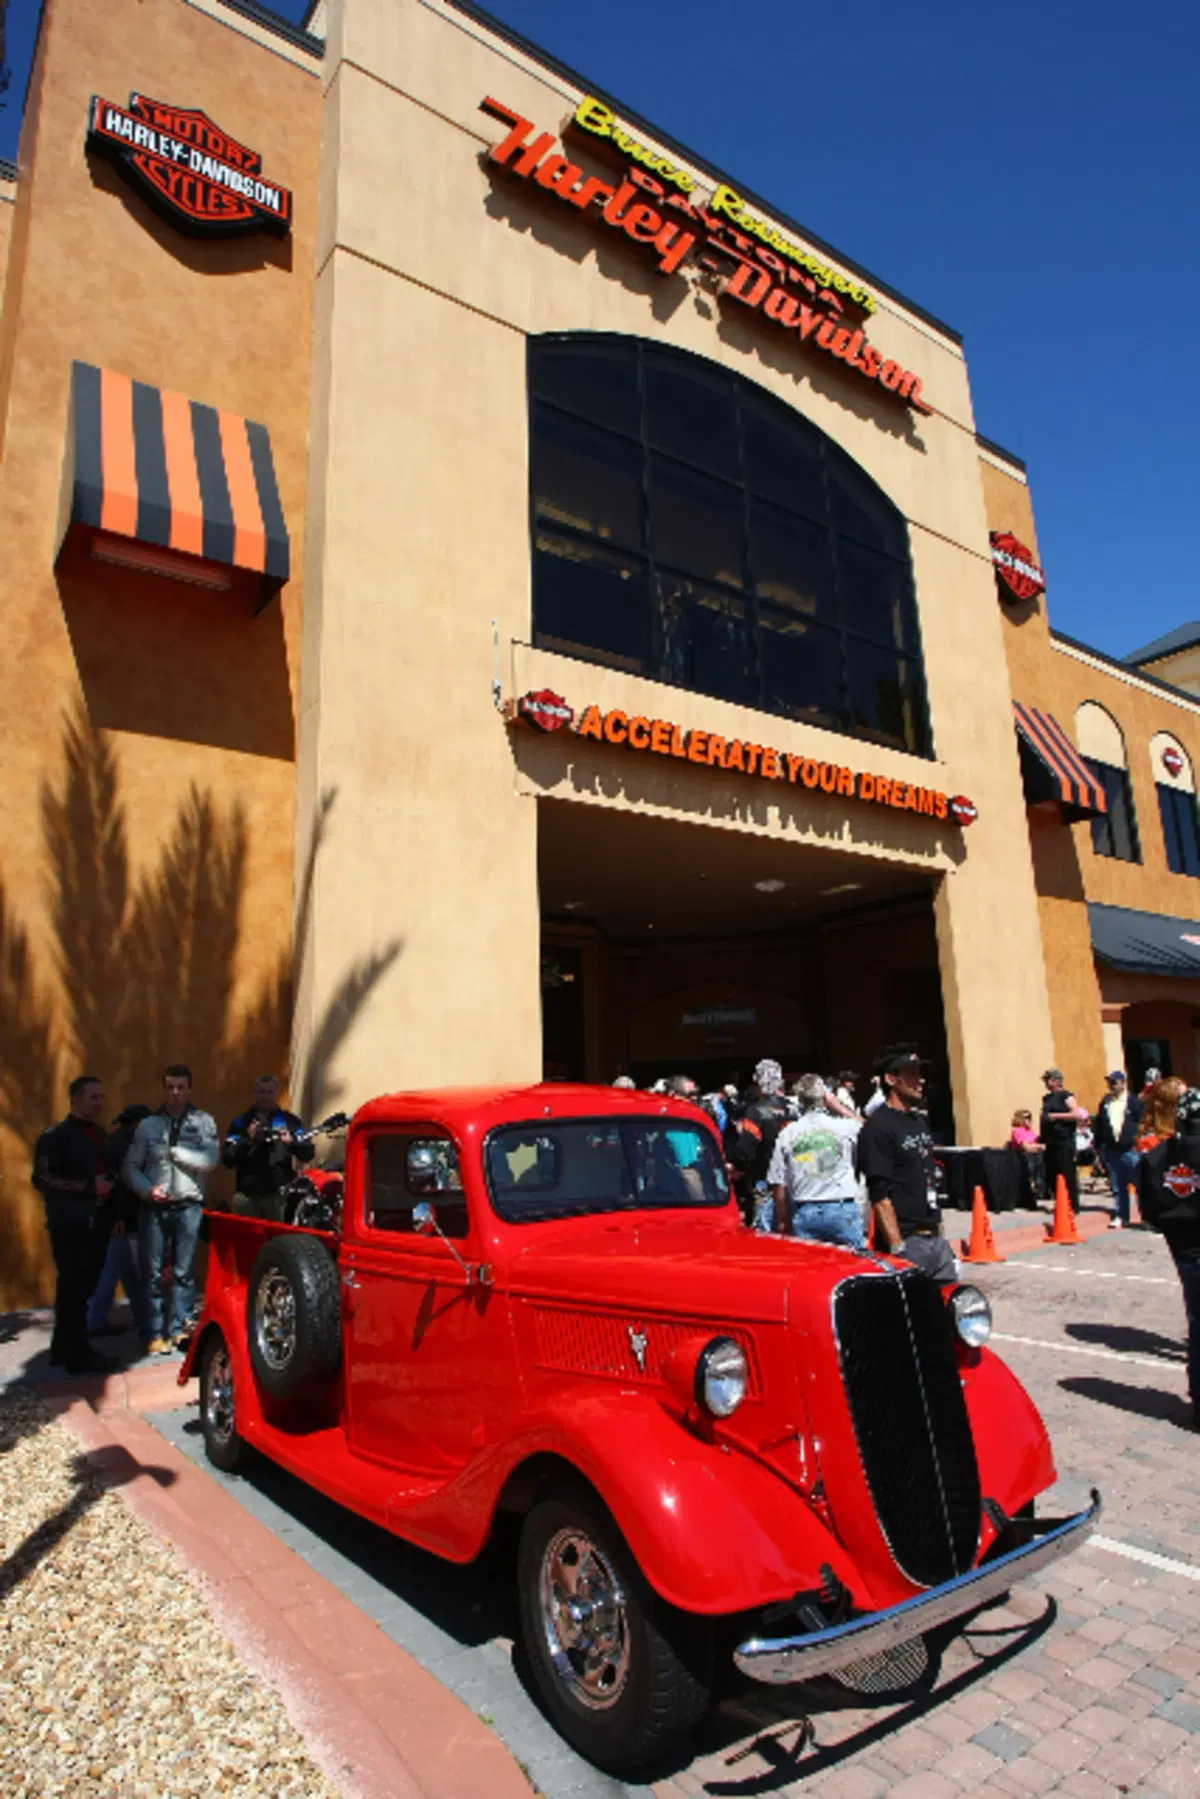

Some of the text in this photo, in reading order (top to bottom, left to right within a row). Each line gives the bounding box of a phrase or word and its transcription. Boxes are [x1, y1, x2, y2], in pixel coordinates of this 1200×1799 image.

[106, 109, 280, 212] HARLEY-DAVIDSON
[153, 106, 242, 165] MOTOR
[575, 95, 696, 192] Bruce
[148, 158, 237, 213] CYCLES
[576, 704, 948, 820] ACCELERATE YOUR DREAMS
